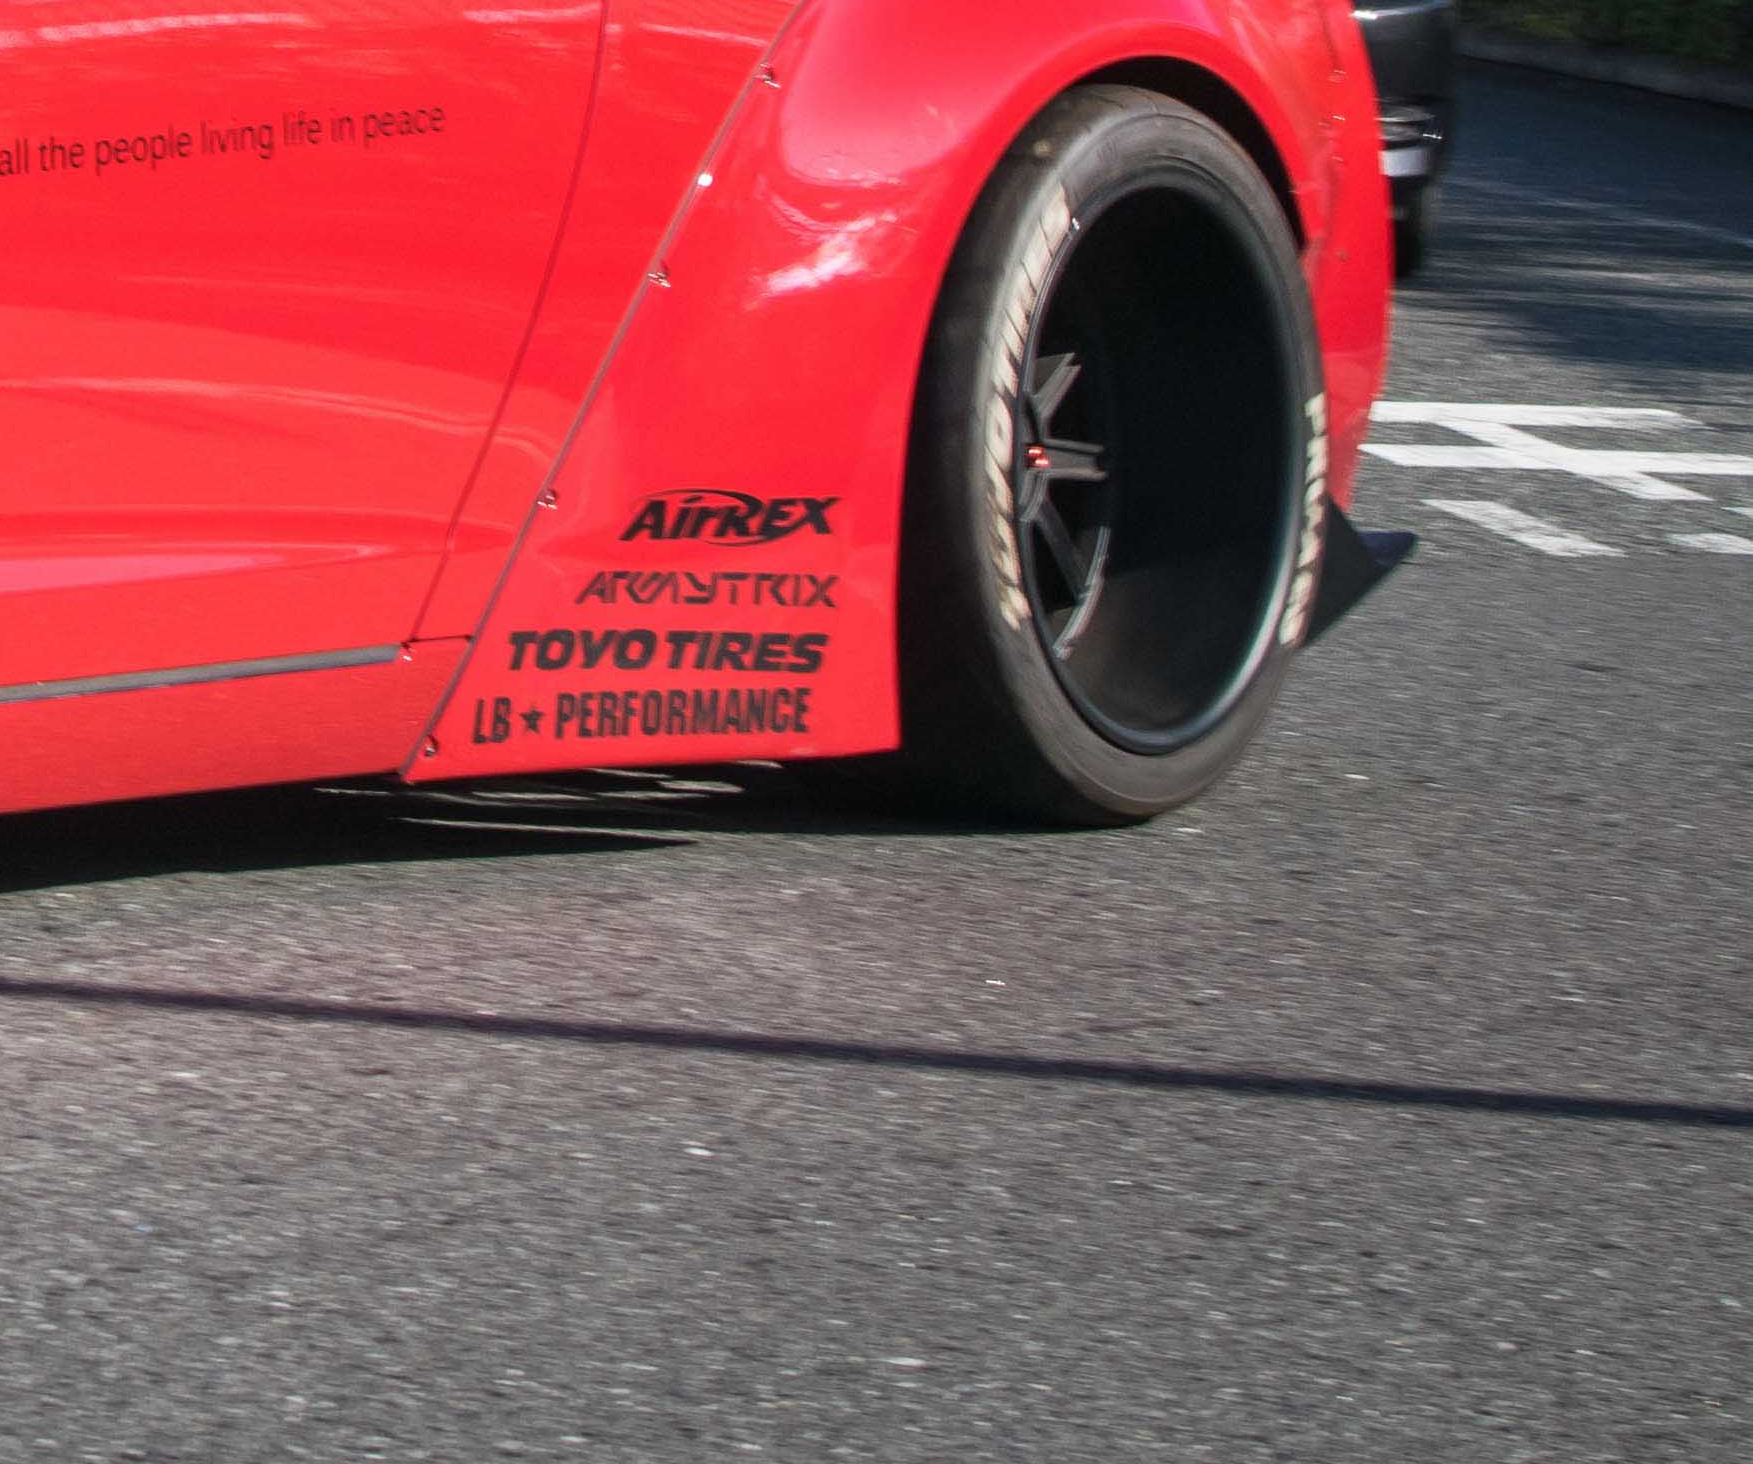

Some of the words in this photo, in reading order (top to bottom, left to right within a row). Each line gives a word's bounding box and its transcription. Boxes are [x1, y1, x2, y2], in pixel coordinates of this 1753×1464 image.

[38, 136, 86, 172] the
[95, 124, 193, 176] people
[200, 119, 275, 159] living
[283, 110, 323, 146] life
[331, 112, 356, 143] in
[363, 106, 445, 149] peace
[575, 571, 840, 607] ARMYTRIX
[509, 629, 657, 670] TOYO
[664, 630, 830, 672] TIRES
[471, 697, 512, 744] LB
[554, 687, 812, 739] PERFORMANCE
